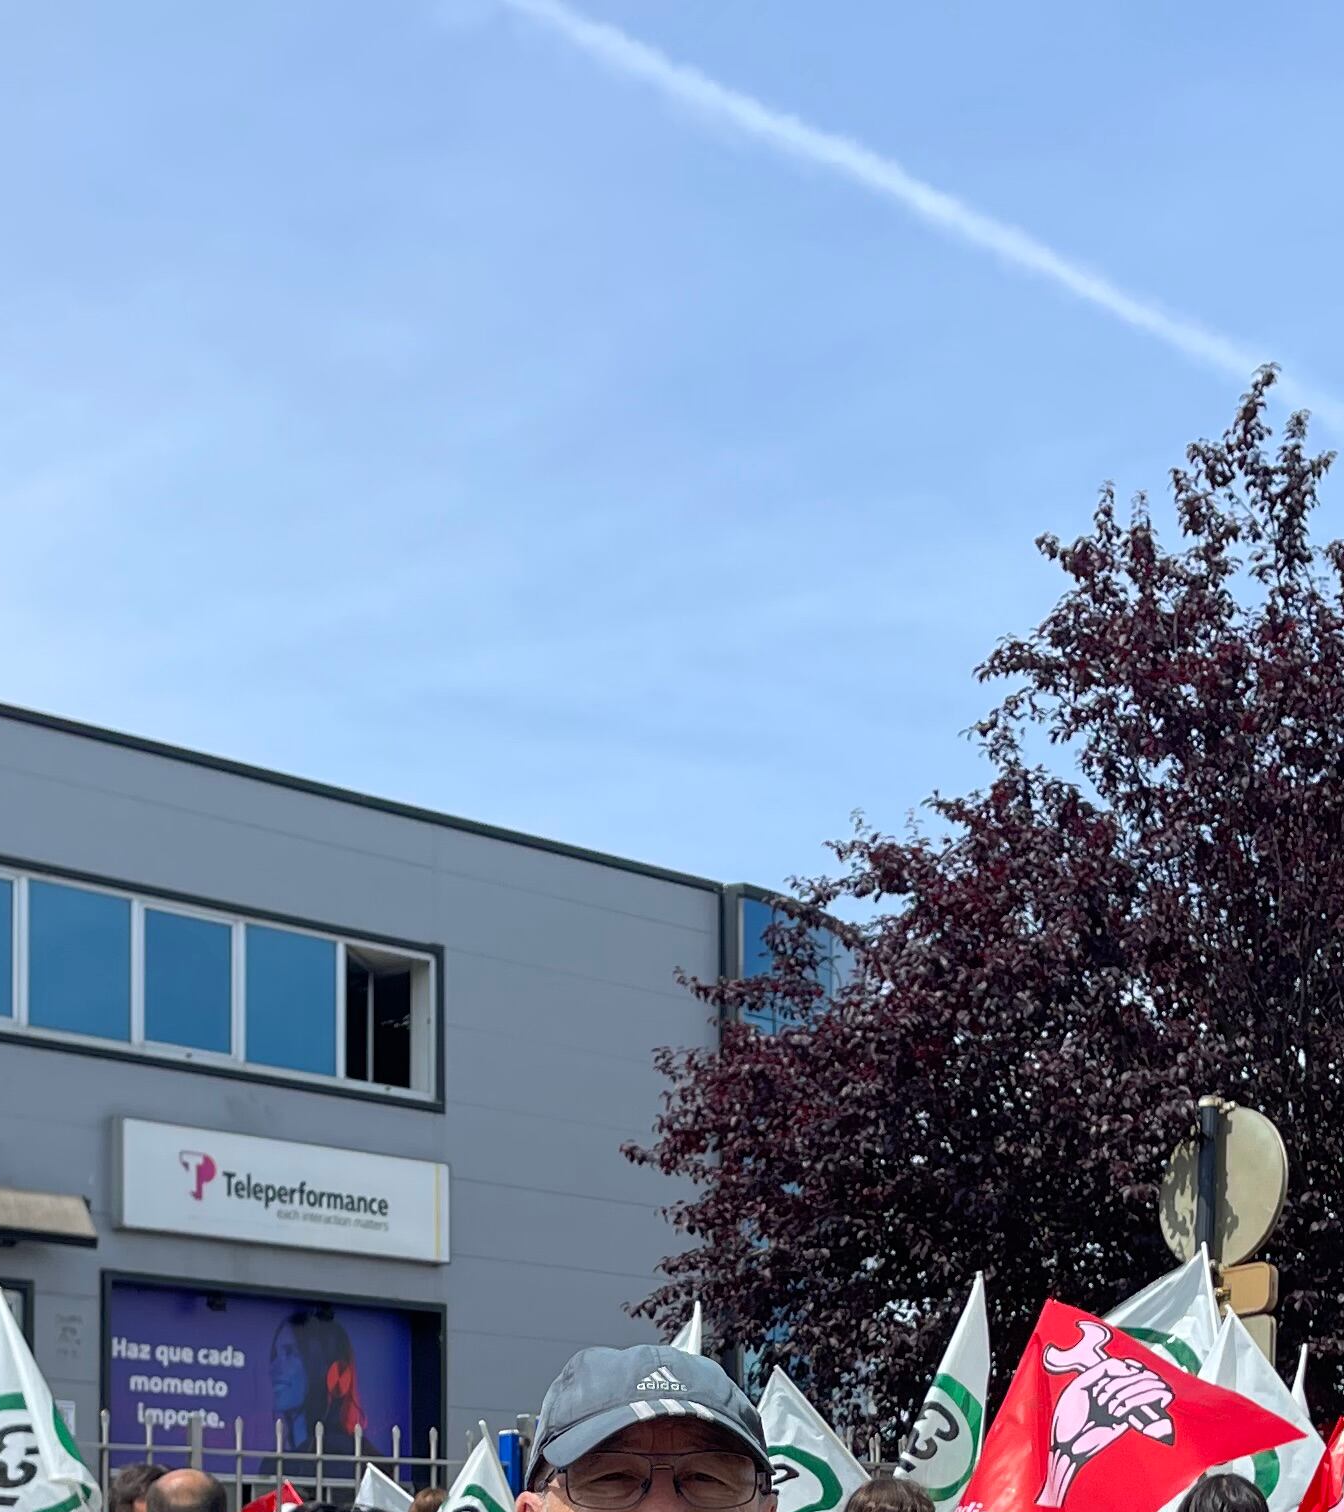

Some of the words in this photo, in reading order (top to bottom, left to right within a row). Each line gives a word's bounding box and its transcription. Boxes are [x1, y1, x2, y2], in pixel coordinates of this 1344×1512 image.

[222, 1170, 390, 1217] Teleperformance
[277, 1209, 300, 1221] each
[301, 1209, 352, 1229] interaction
[353, 1216, 390, 1232] matters
[112, 1336, 151, 1361] Haz
[155, 1344, 194, 1368] que
[197, 1345, 246, 1369] cada
[129, 1374, 229, 1398] momento
